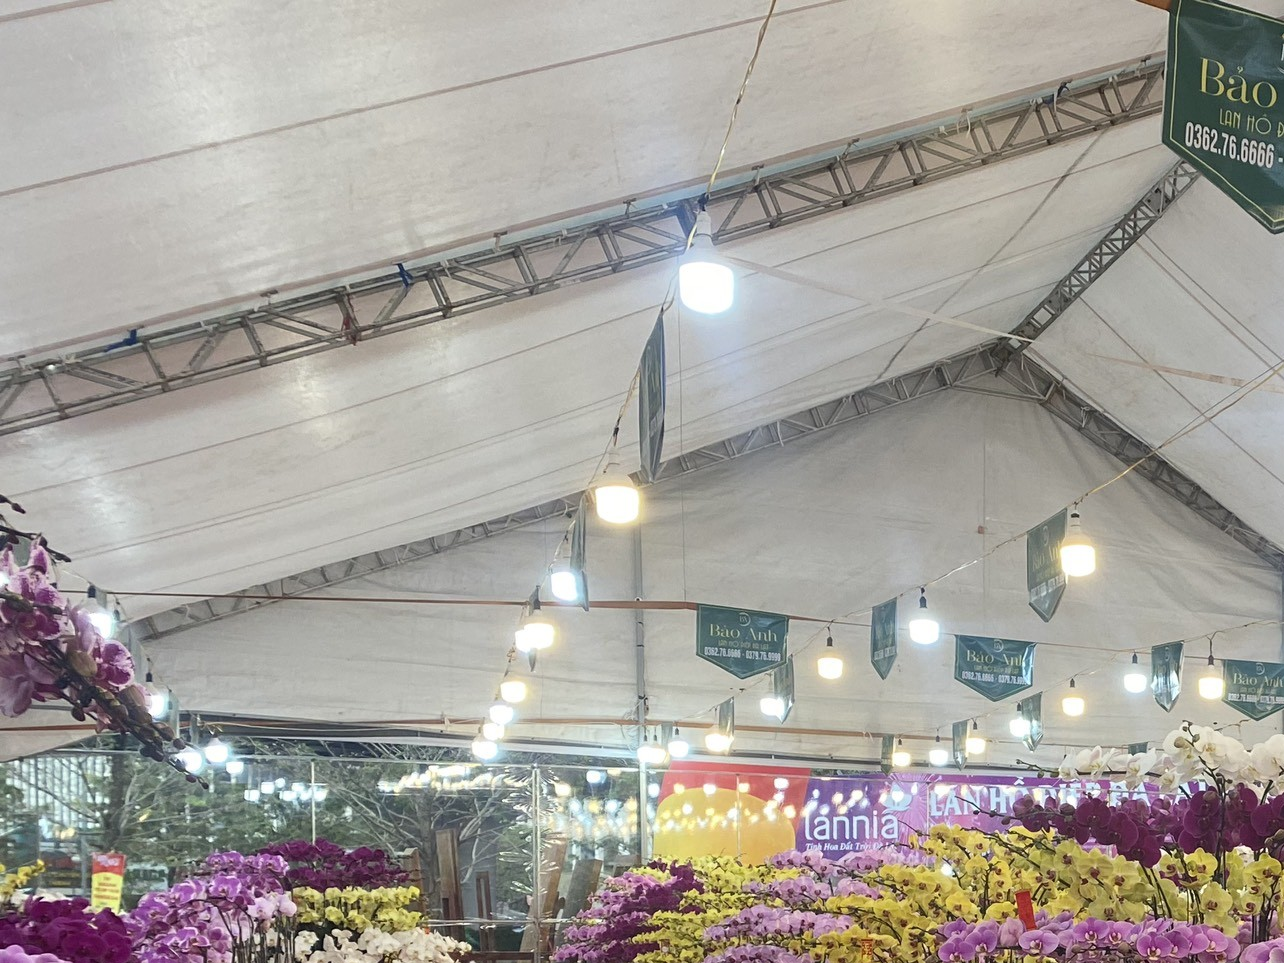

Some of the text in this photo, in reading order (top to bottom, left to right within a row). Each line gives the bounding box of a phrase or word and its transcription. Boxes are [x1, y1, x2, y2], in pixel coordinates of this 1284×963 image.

[1199, 57, 1278, 108] Bảo
[1219, 108, 1241, 129] LAN
[1185, 122, 1275, 168] 0362.76.6666
